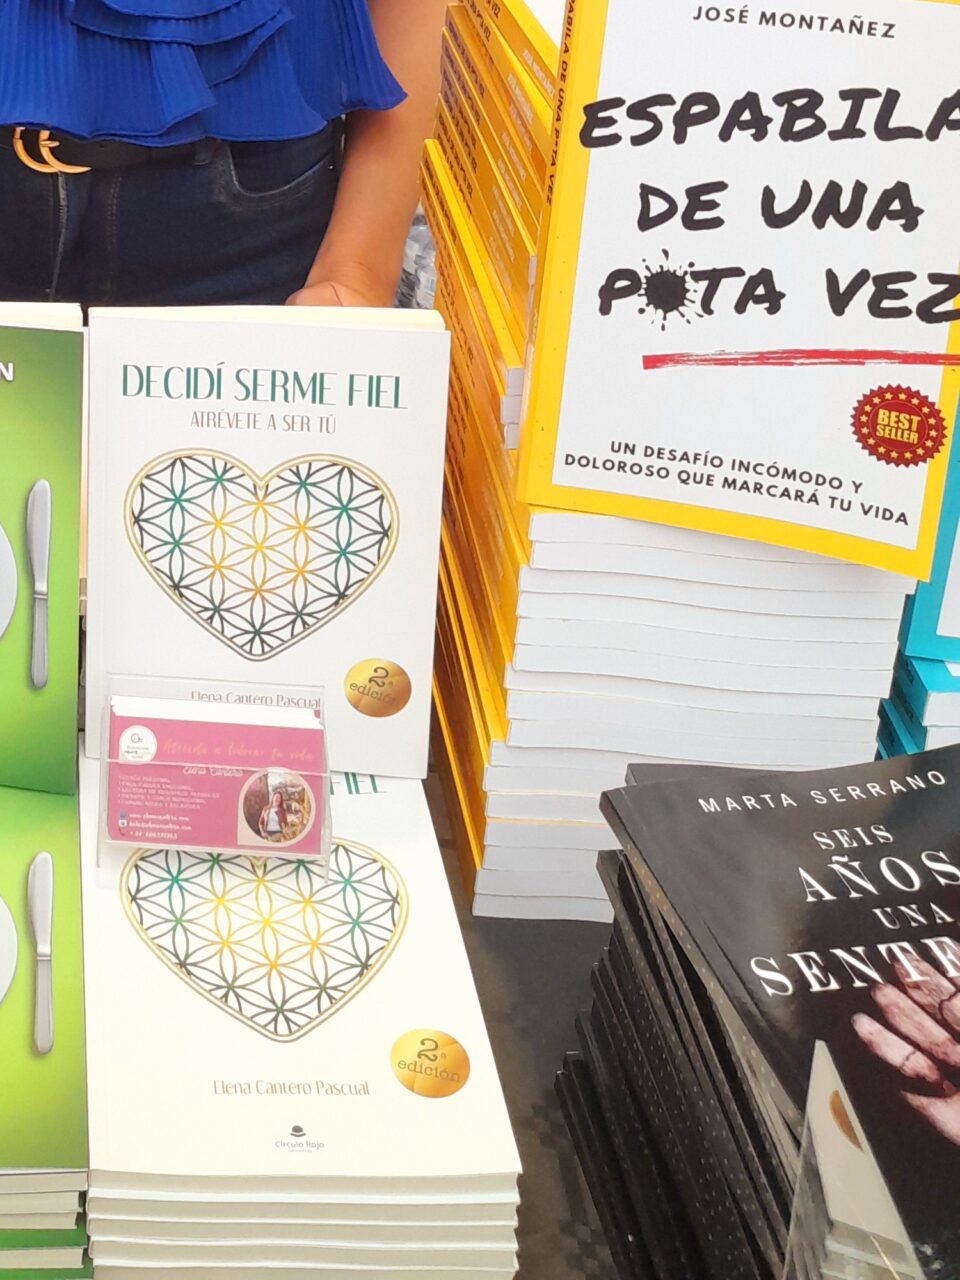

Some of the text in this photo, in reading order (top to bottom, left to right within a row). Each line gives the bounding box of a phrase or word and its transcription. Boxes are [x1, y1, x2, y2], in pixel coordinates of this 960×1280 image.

[693, 2, 897, 39] JOSÉ MONTAÑEZ
[578, 87, 960, 149] ESPABILA
[636, 179, 925, 234] DE UNA
[824, 267, 960, 324] VEZ
[121, 361, 408, 410] DECIDÍ SERME FIEL
[190, 408, 337, 434] ATRÉVETE A SER TÚ
[876, 424, 919, 445] SELLER
[877, 408, 921, 429] BEST
[610, 440, 864, 494] UN DESAFÍO INCÓMODO Y
[564, 452, 910, 527] DOLOROSO QUE MARCARÁ TU VIDA
[349, 681, 398, 706] edición
[698, 769, 947, 814] MARTA SERRANO
[812, 823, 894, 851] SEIS
[798, 849, 960, 902] AÑOS
[872, 902, 955, 930] UNA
[213, 1079, 370, 1096] Elena Cantero Pascual
[396, 1057, 462, 1084] edición
